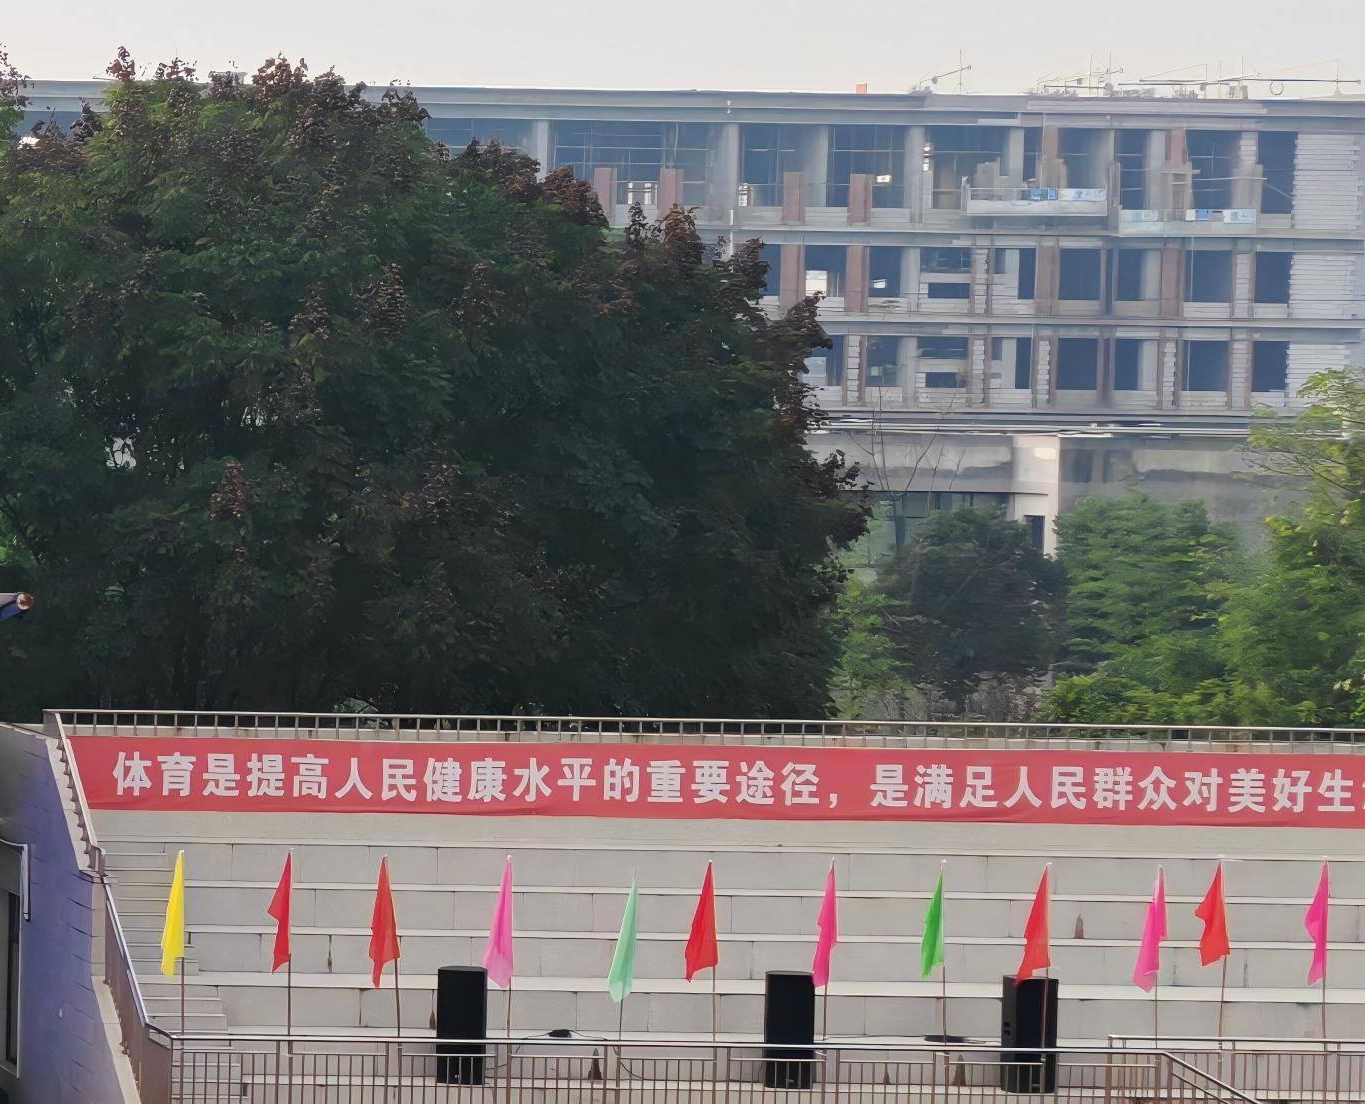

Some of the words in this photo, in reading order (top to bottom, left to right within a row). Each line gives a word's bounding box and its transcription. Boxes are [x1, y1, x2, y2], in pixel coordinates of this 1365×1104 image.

[112, 751, 1365, 813] 体育是提高人民健康水平的重要途径，是满足人民群众对美好生
